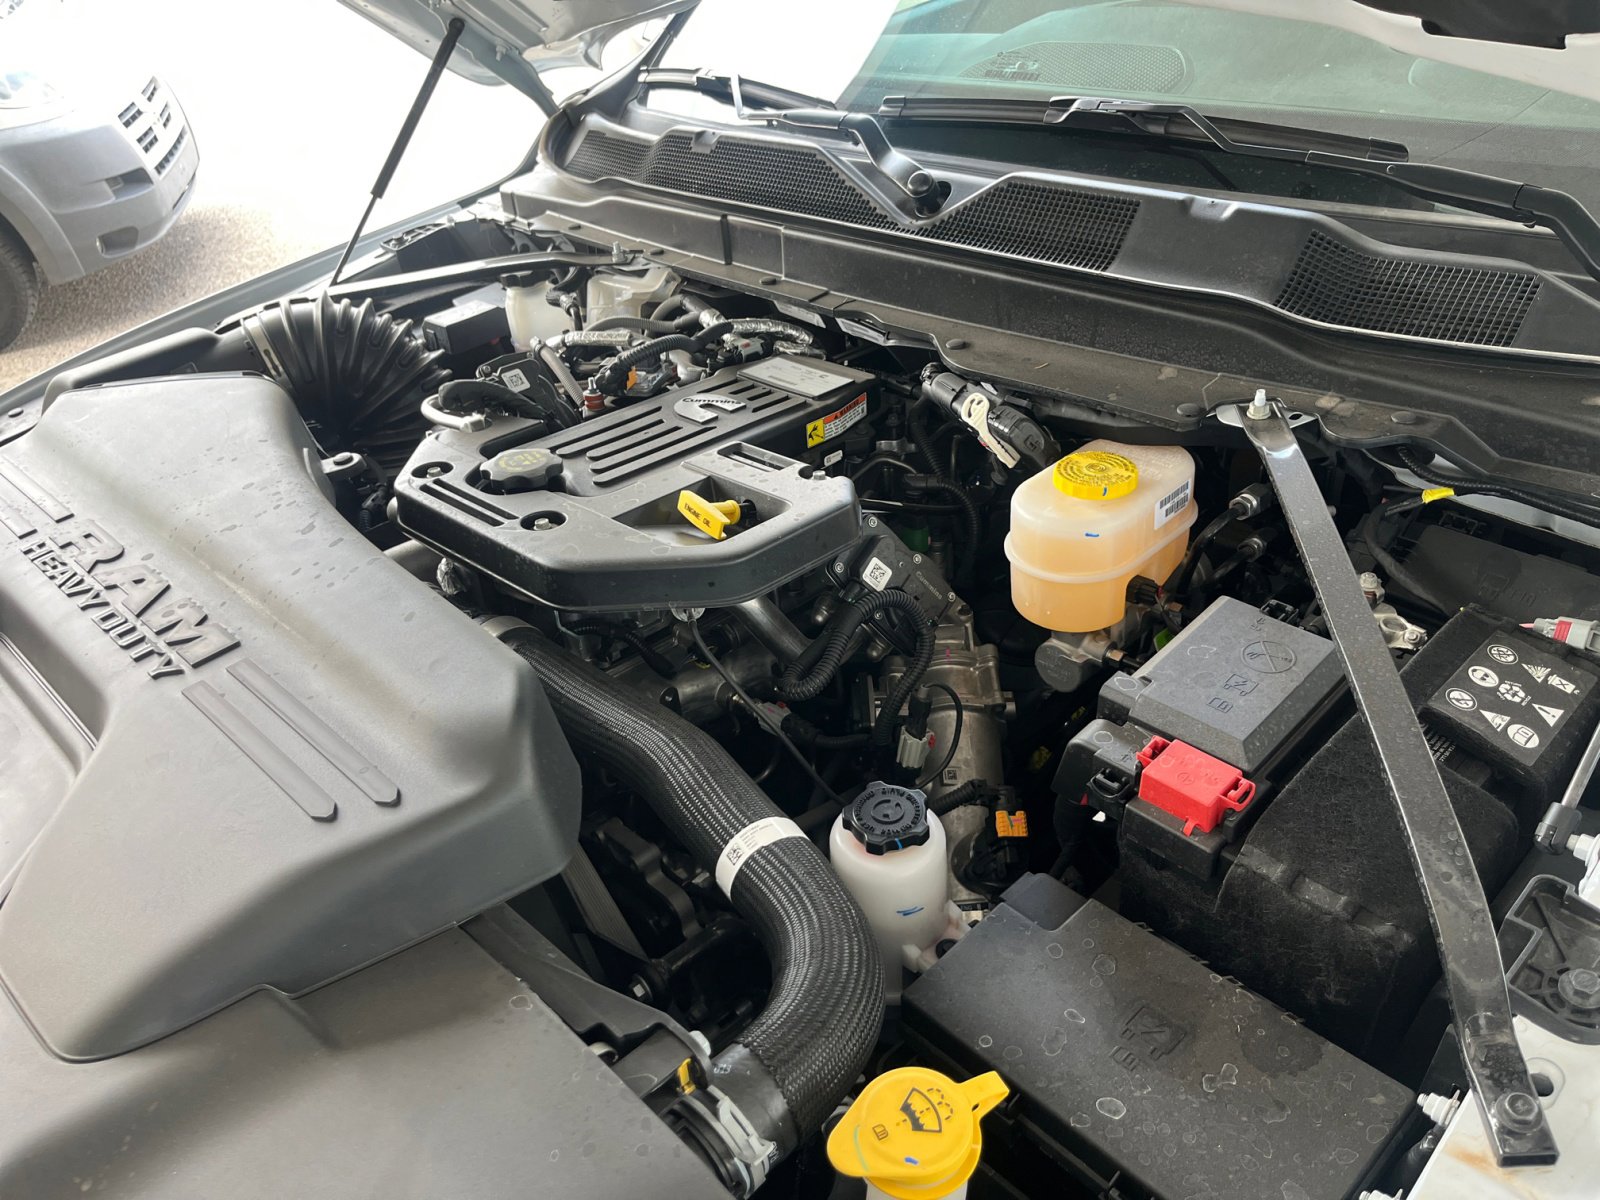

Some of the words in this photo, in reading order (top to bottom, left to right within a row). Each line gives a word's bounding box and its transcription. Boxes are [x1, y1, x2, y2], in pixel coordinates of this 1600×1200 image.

[684, 503, 701, 520] ENGINE
[703, 518, 711, 528] OIL
[20, 539, 110, 612] HEAVY
[91, 607, 185, 680] DUTY
[49, 518, 241, 669] RAM
[915, 570, 943, 600] Cummins
